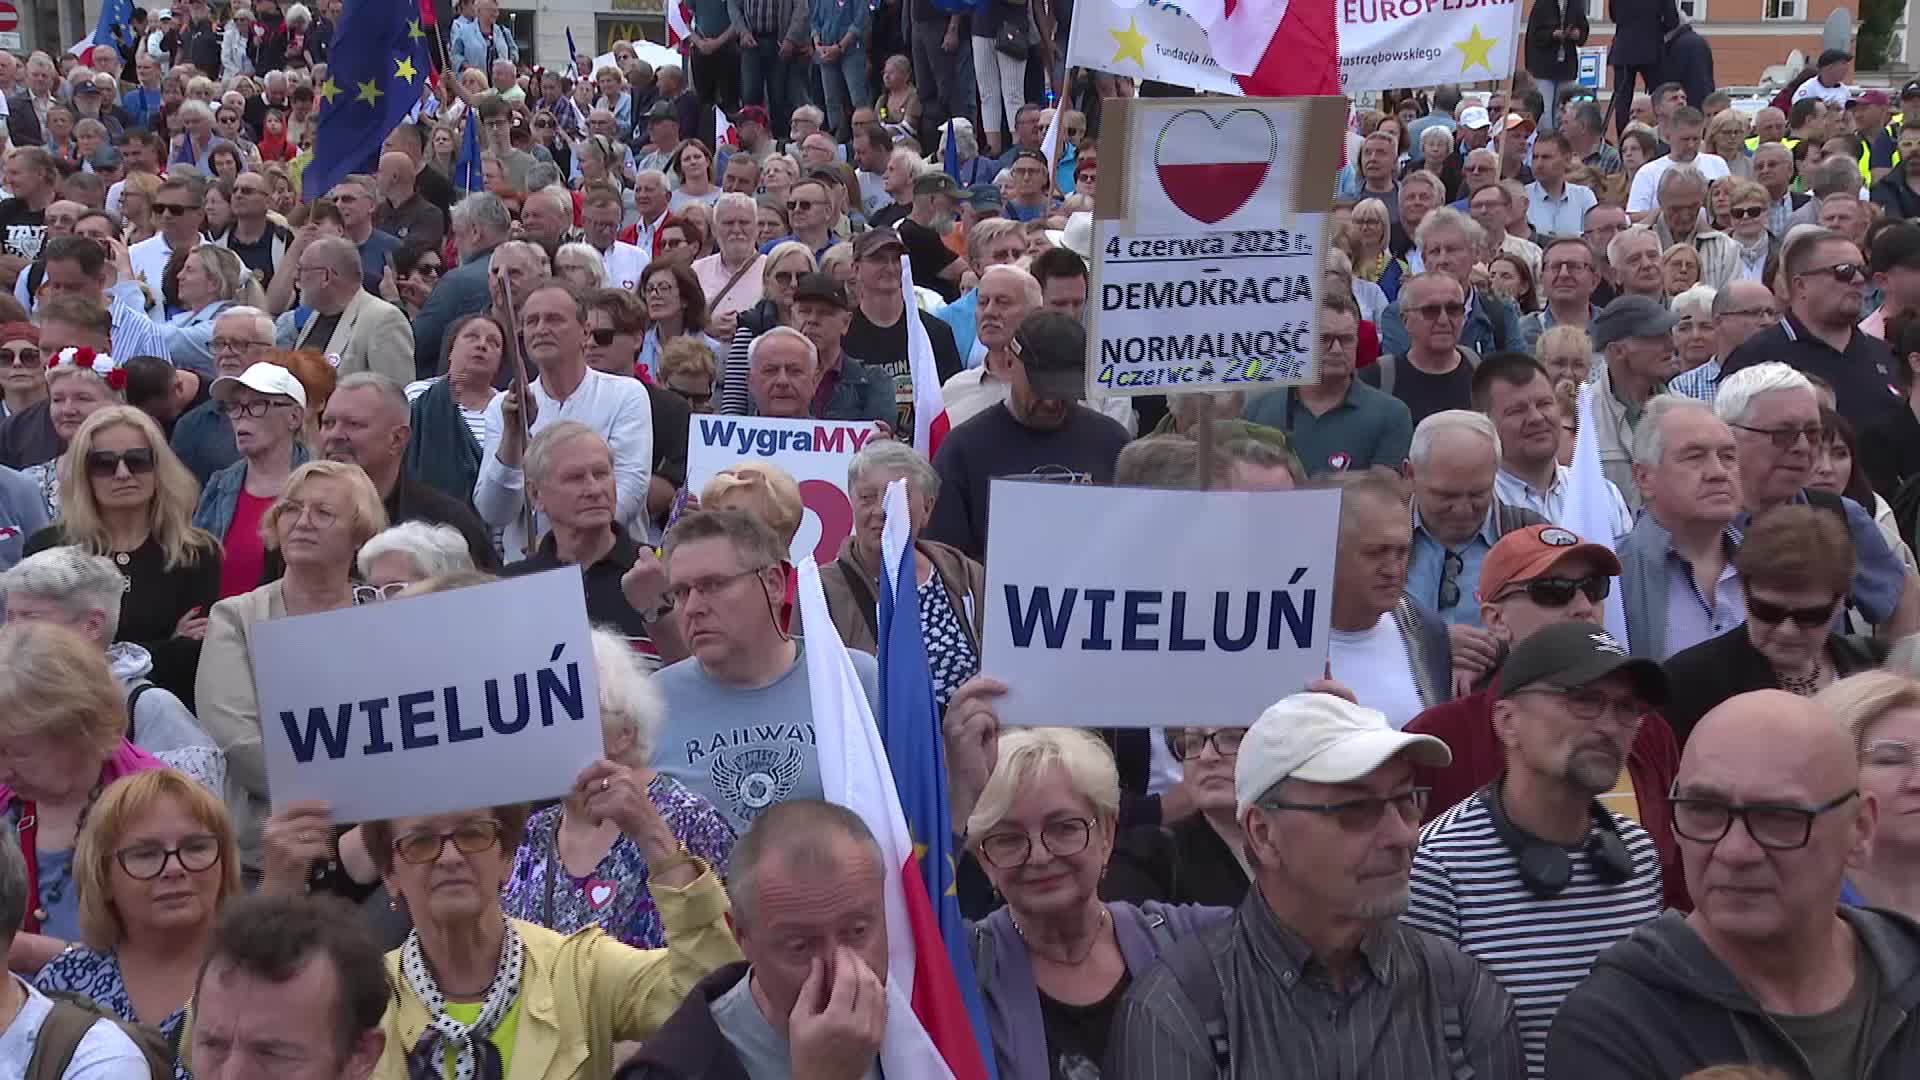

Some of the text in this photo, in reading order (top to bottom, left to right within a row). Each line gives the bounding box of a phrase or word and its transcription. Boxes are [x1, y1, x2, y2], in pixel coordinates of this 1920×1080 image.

[1344, 0, 1514, 24] EUROP
[1155, 43, 1199, 65] Fundacja
[1105, 229, 1313, 258] 4 czerwca 2023 r.
[1102, 274, 1313, 311] DEMOKRACJA
[1100, 320, 1311, 365] NORMALNOŚĆ
[699, 418, 872, 457] WygraMY
[1003, 567, 1317, 652] WIELUŃ
[279, 641, 585, 763] WIELUŃ
[685, 723, 817, 764] RAILWAY
